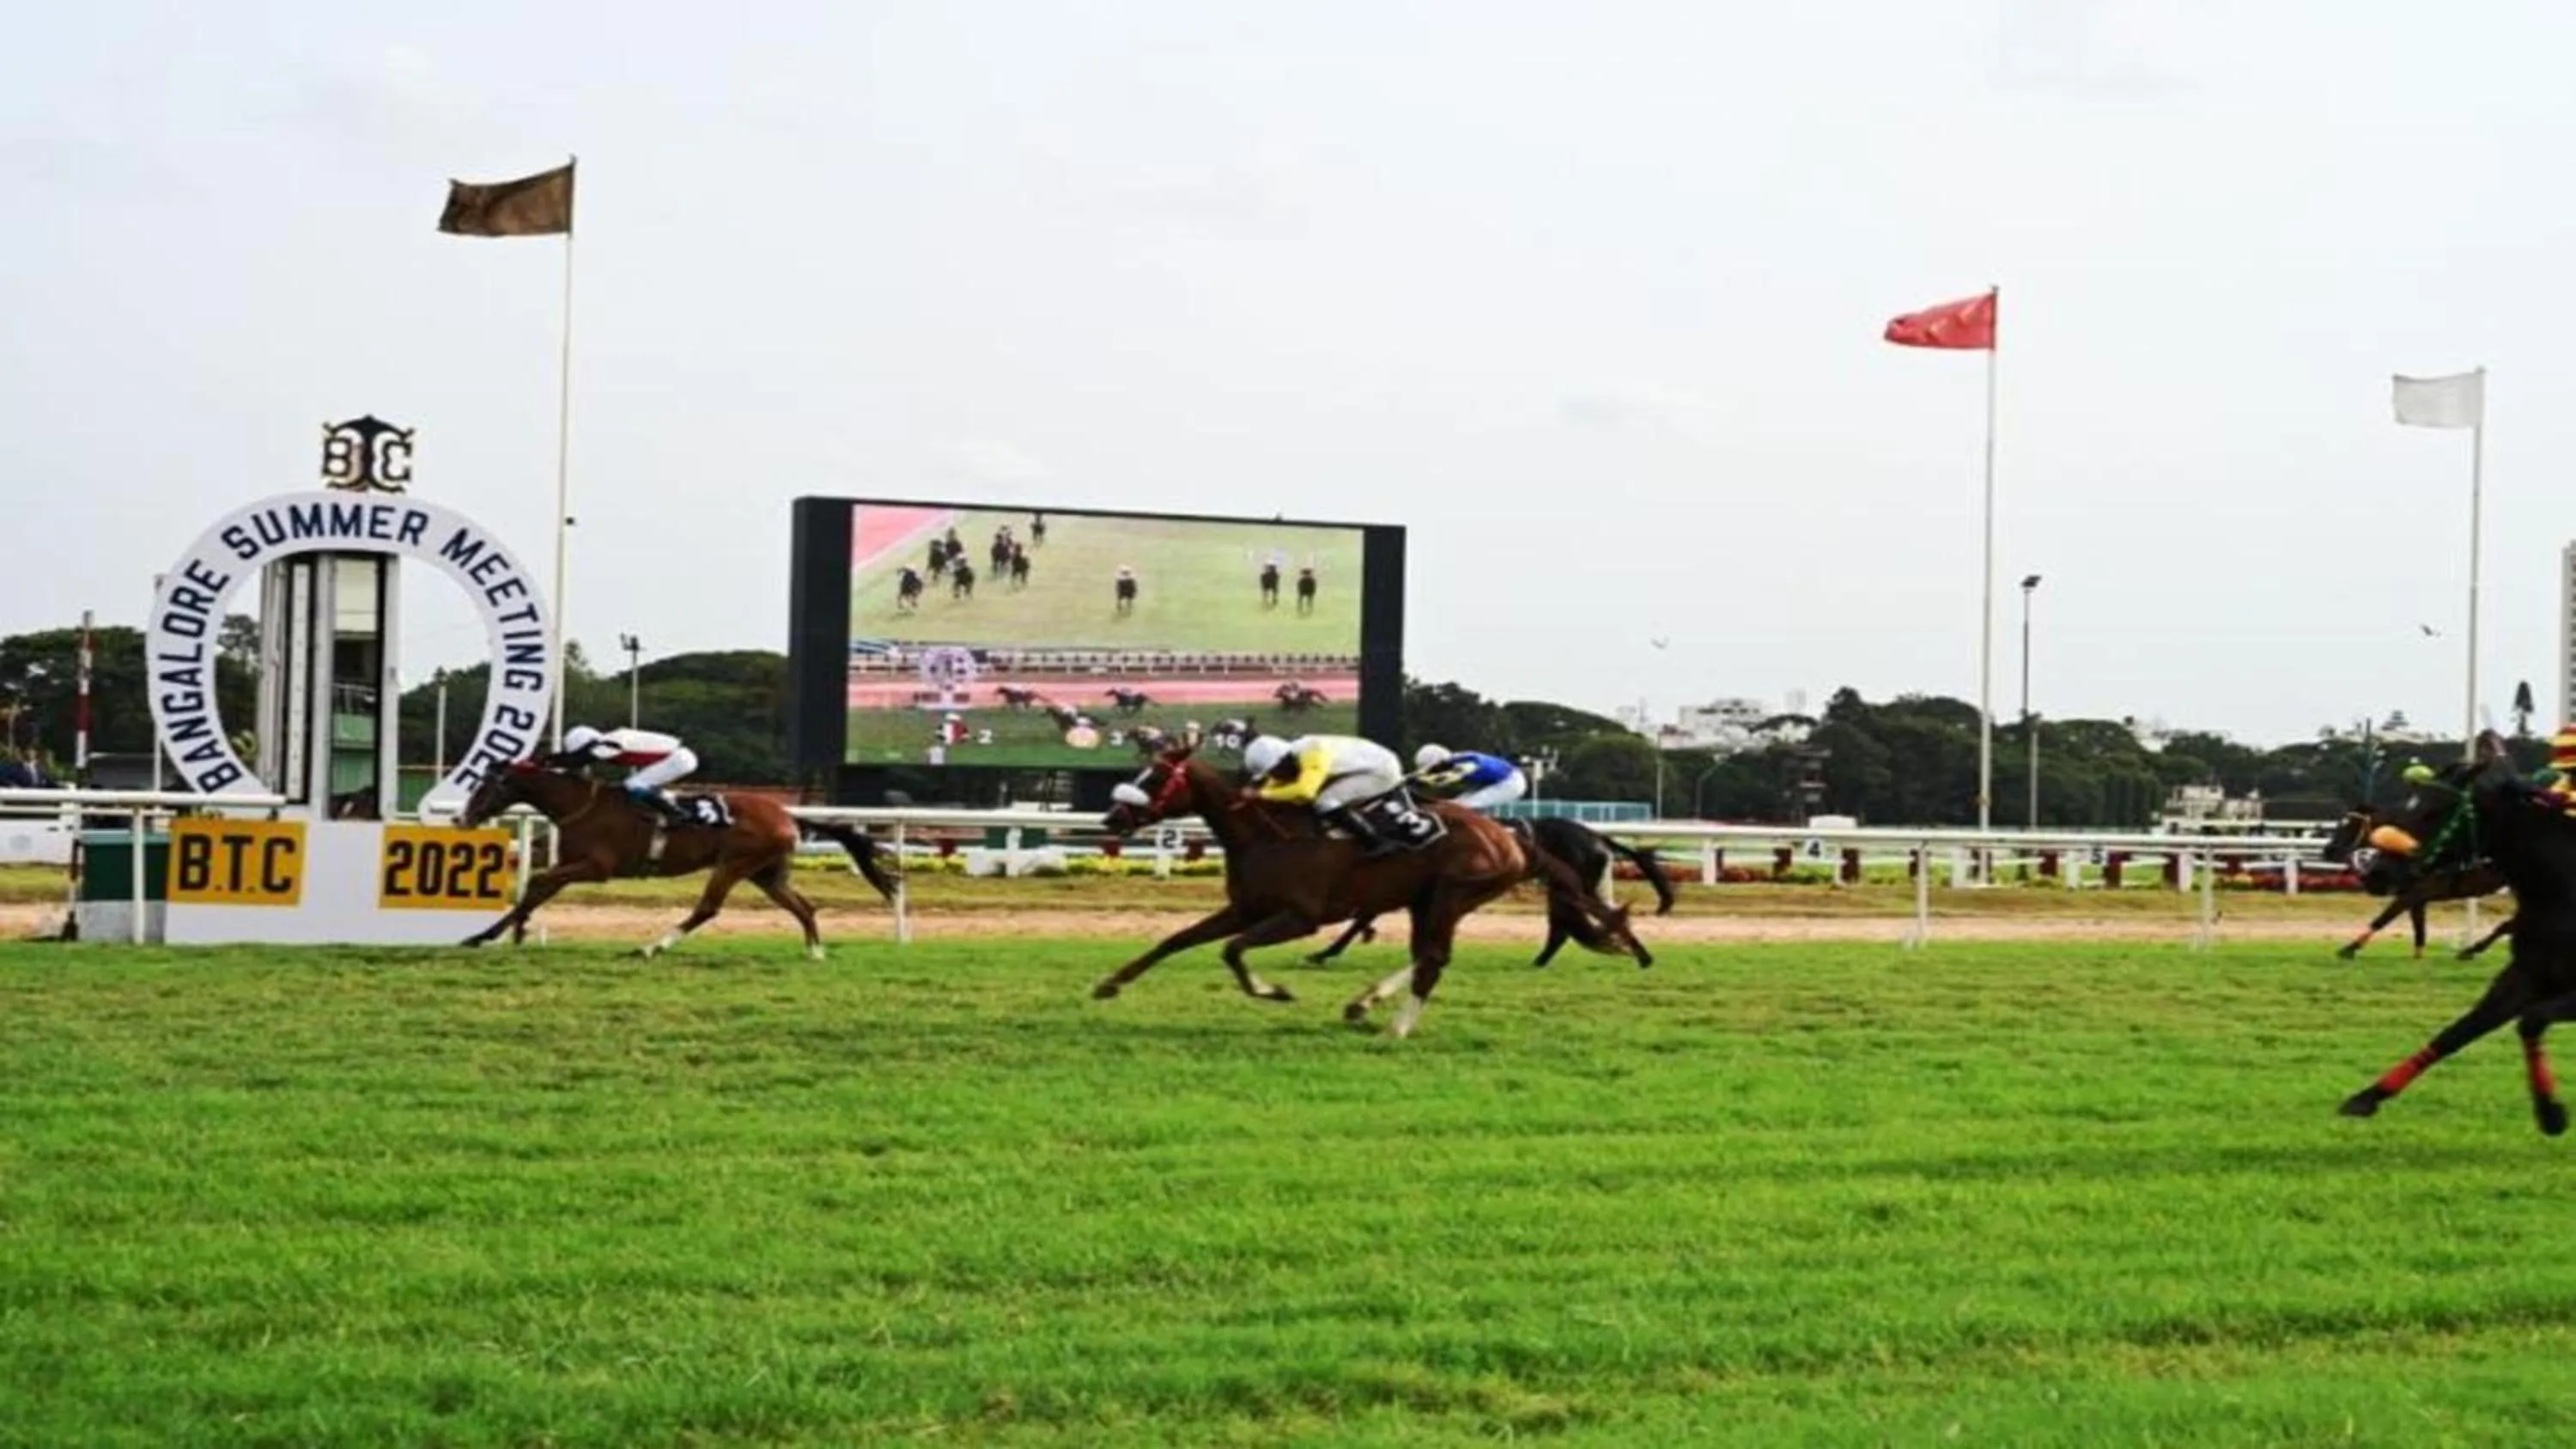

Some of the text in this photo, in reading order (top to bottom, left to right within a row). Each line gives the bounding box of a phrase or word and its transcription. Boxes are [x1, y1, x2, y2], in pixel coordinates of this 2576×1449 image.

[157, 558, 243, 794] BANGALORE
[220, 501, 429, 561] SUMMER
[438, 526, 545, 693] MEETING
[178, 833, 296, 894] B.T.C
[384, 839, 505, 899] 2022
[1162, 828, 1177, 850] 2
